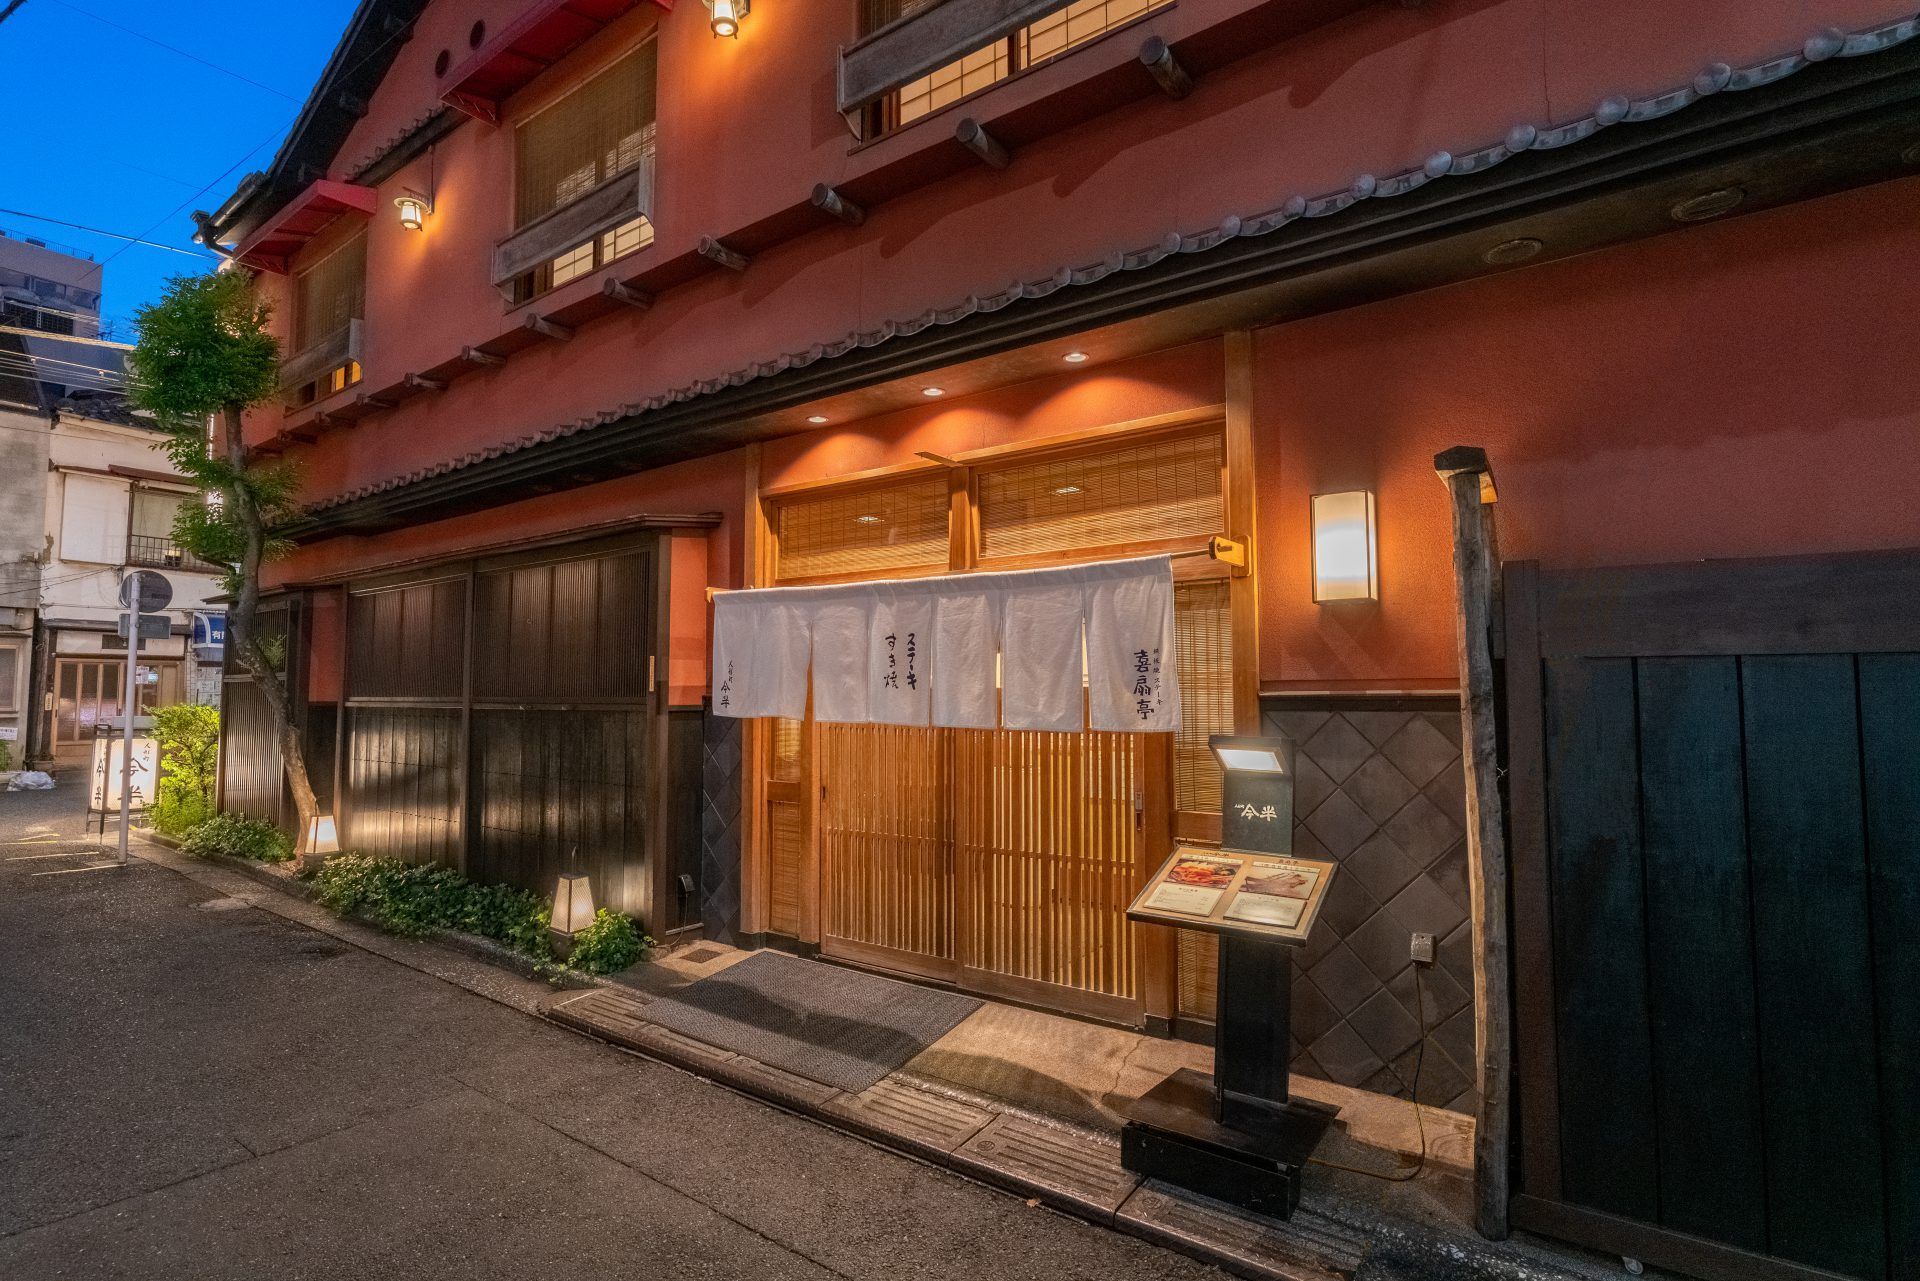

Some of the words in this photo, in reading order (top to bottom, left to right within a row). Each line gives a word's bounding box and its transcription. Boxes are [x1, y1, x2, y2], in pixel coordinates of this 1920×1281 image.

[907, 633, 917, 690] ステーキ
[720, 680, 731, 709] 今半
[1133, 649, 1155, 720] 喜扇亭
[1241, 803, 1277, 821] 今半
